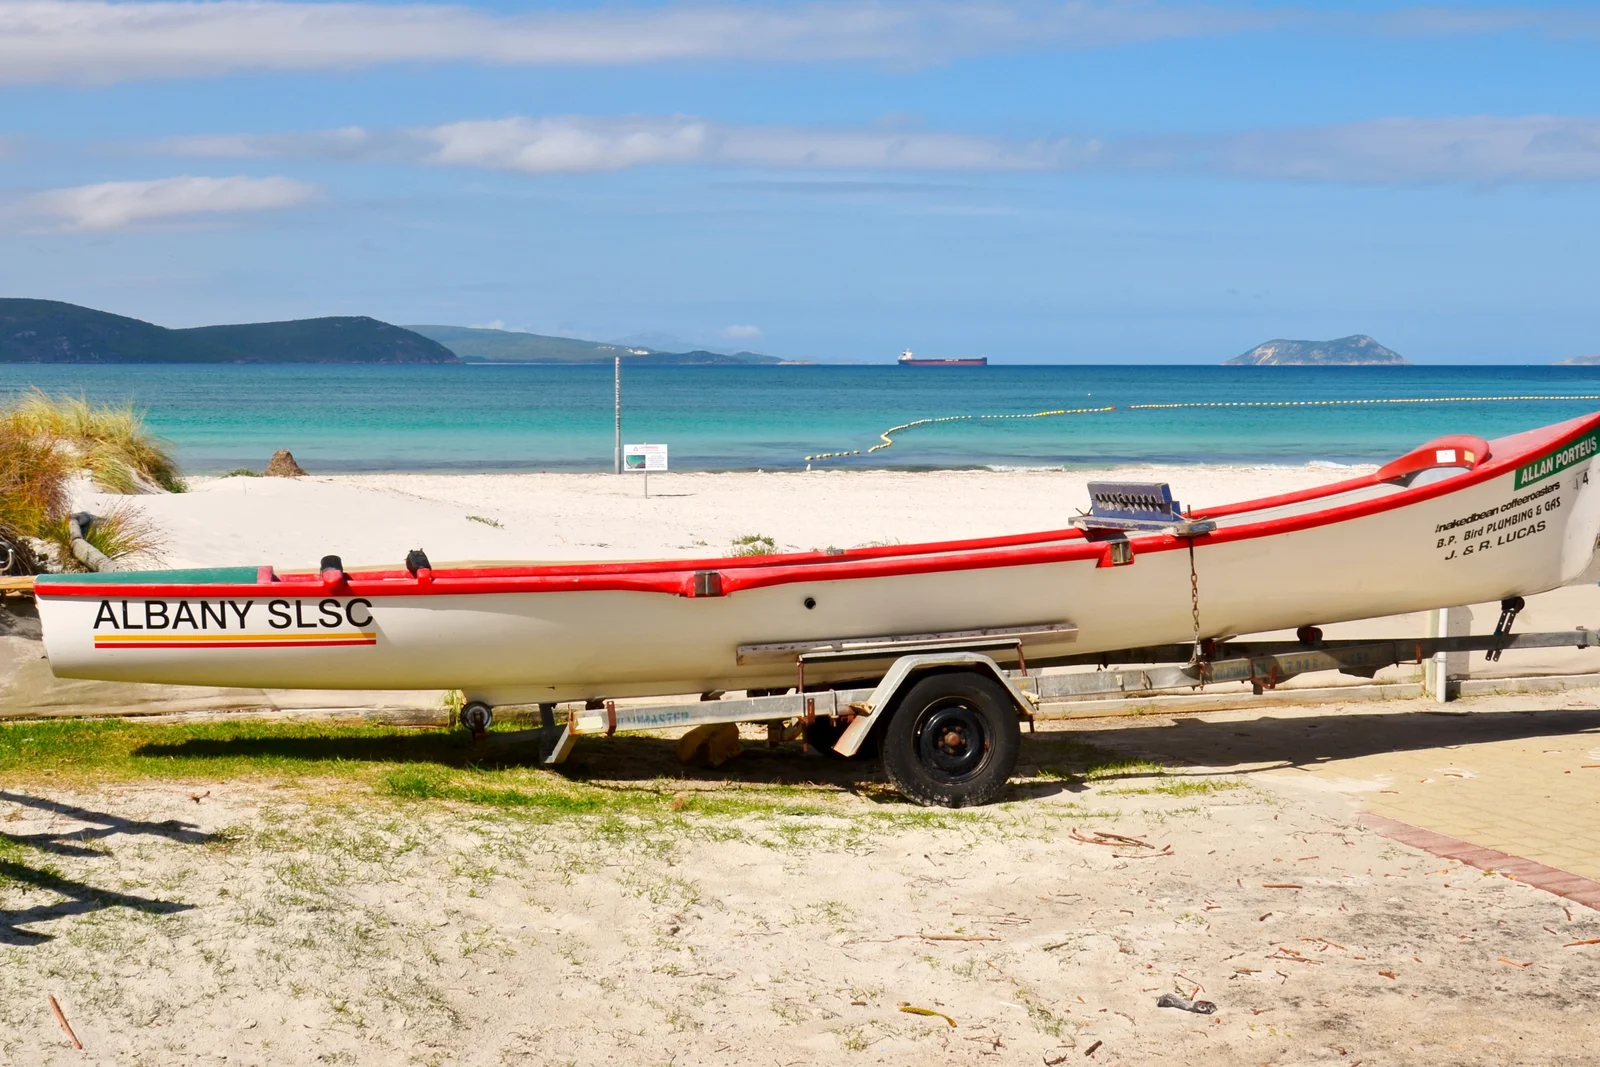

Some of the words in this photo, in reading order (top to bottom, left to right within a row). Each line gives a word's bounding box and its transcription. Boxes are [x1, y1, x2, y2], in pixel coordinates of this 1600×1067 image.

[1521, 457, 1554, 484] ALLAN
[1556, 436, 1597, 468] PORTEUS
[1500, 481, 1560, 513] coffeeroasters
[1463, 526, 1484, 541] Bird
[1486, 508, 1533, 534] PLUMBING
[1536, 504, 1542, 515] &
[1544, 496, 1561, 511] GAS
[1444, 550, 1458, 560] J.
[1463, 545, 1474, 556] &
[1478, 540, 1493, 551] R.
[1497, 520, 1546, 546] LUCAS
[93, 600, 254, 629] ALBANY
[268, 598, 374, 629] SLSC
